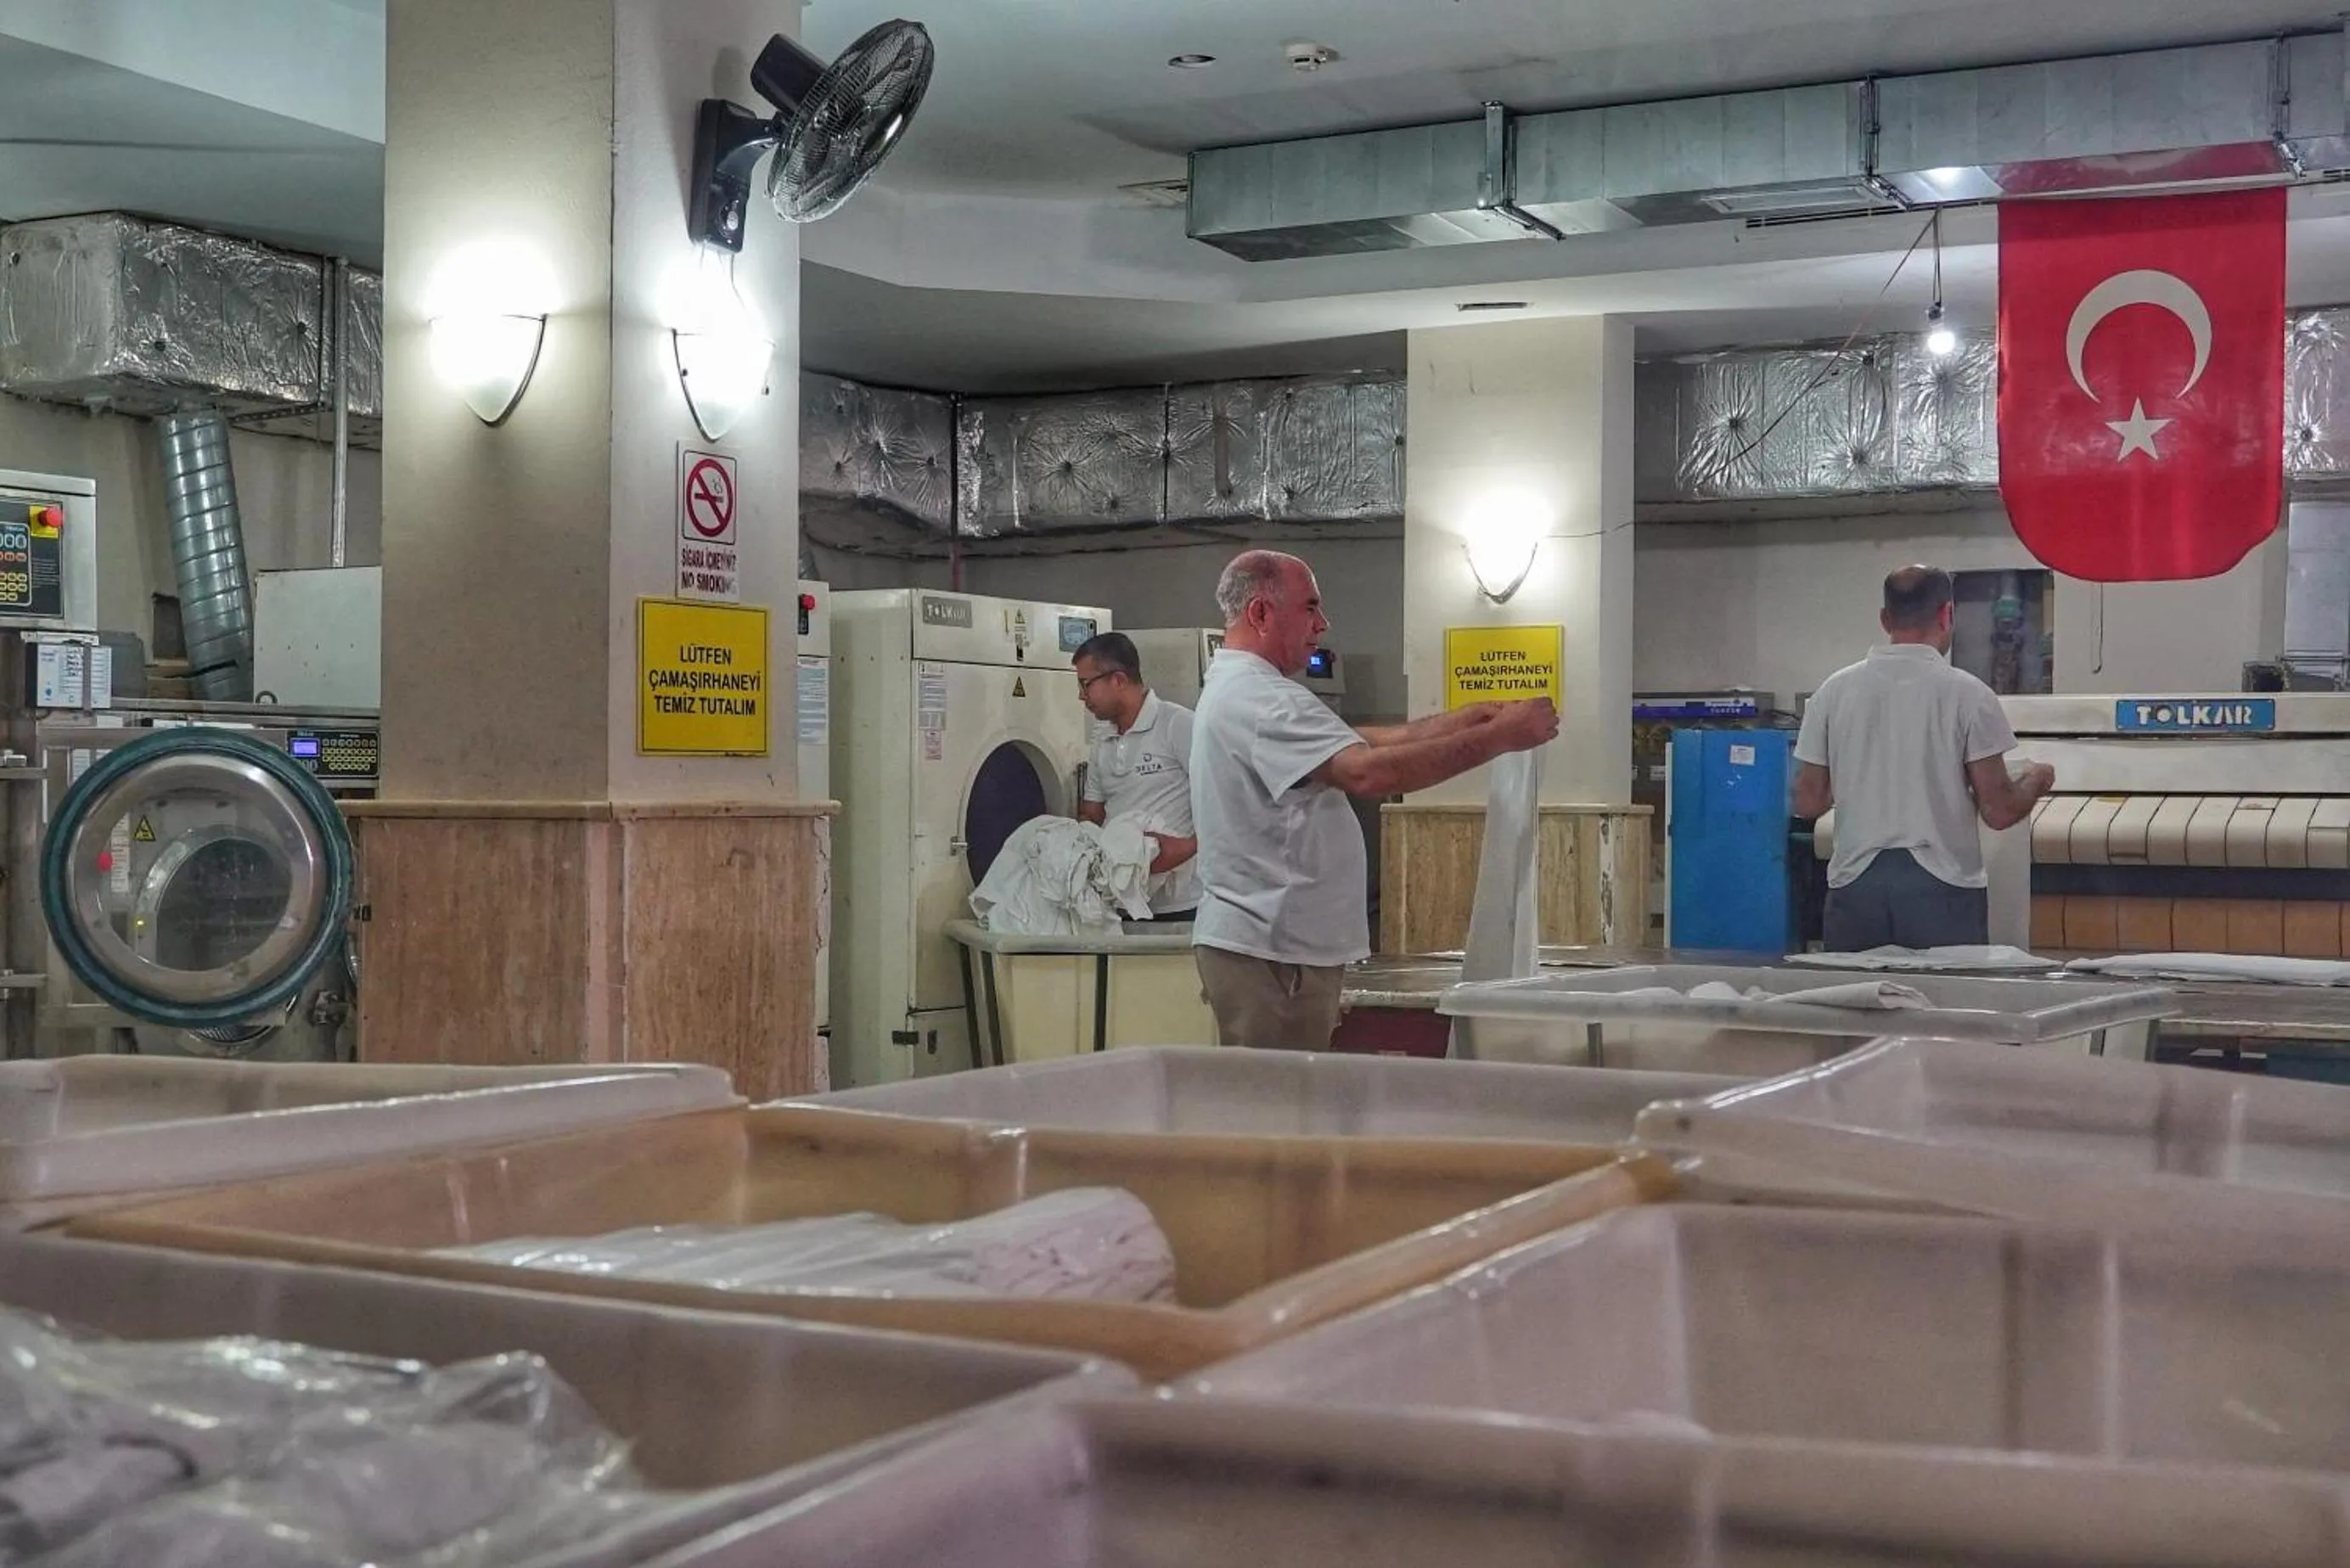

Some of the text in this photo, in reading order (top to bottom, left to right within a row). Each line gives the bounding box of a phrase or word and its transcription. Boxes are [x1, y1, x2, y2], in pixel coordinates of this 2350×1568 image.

[681, 570, 695, 590] NO
[680, 643, 732, 665] LÜTFEN
[1480, 649, 1526, 661] LÜTFEN
[1454, 663, 1553, 677] ÇAMAŞIRHANEYİ
[649, 669, 762, 692] ÇAMAŞIRHANEYİ
[1459, 678, 1548, 690] TEMİZ TUTALIM
[654, 691, 756, 716] TEMİZ TUTALIM
[2136, 705, 2252, 724] TOLKAR
[1135, 763, 1162, 773] DELTA
